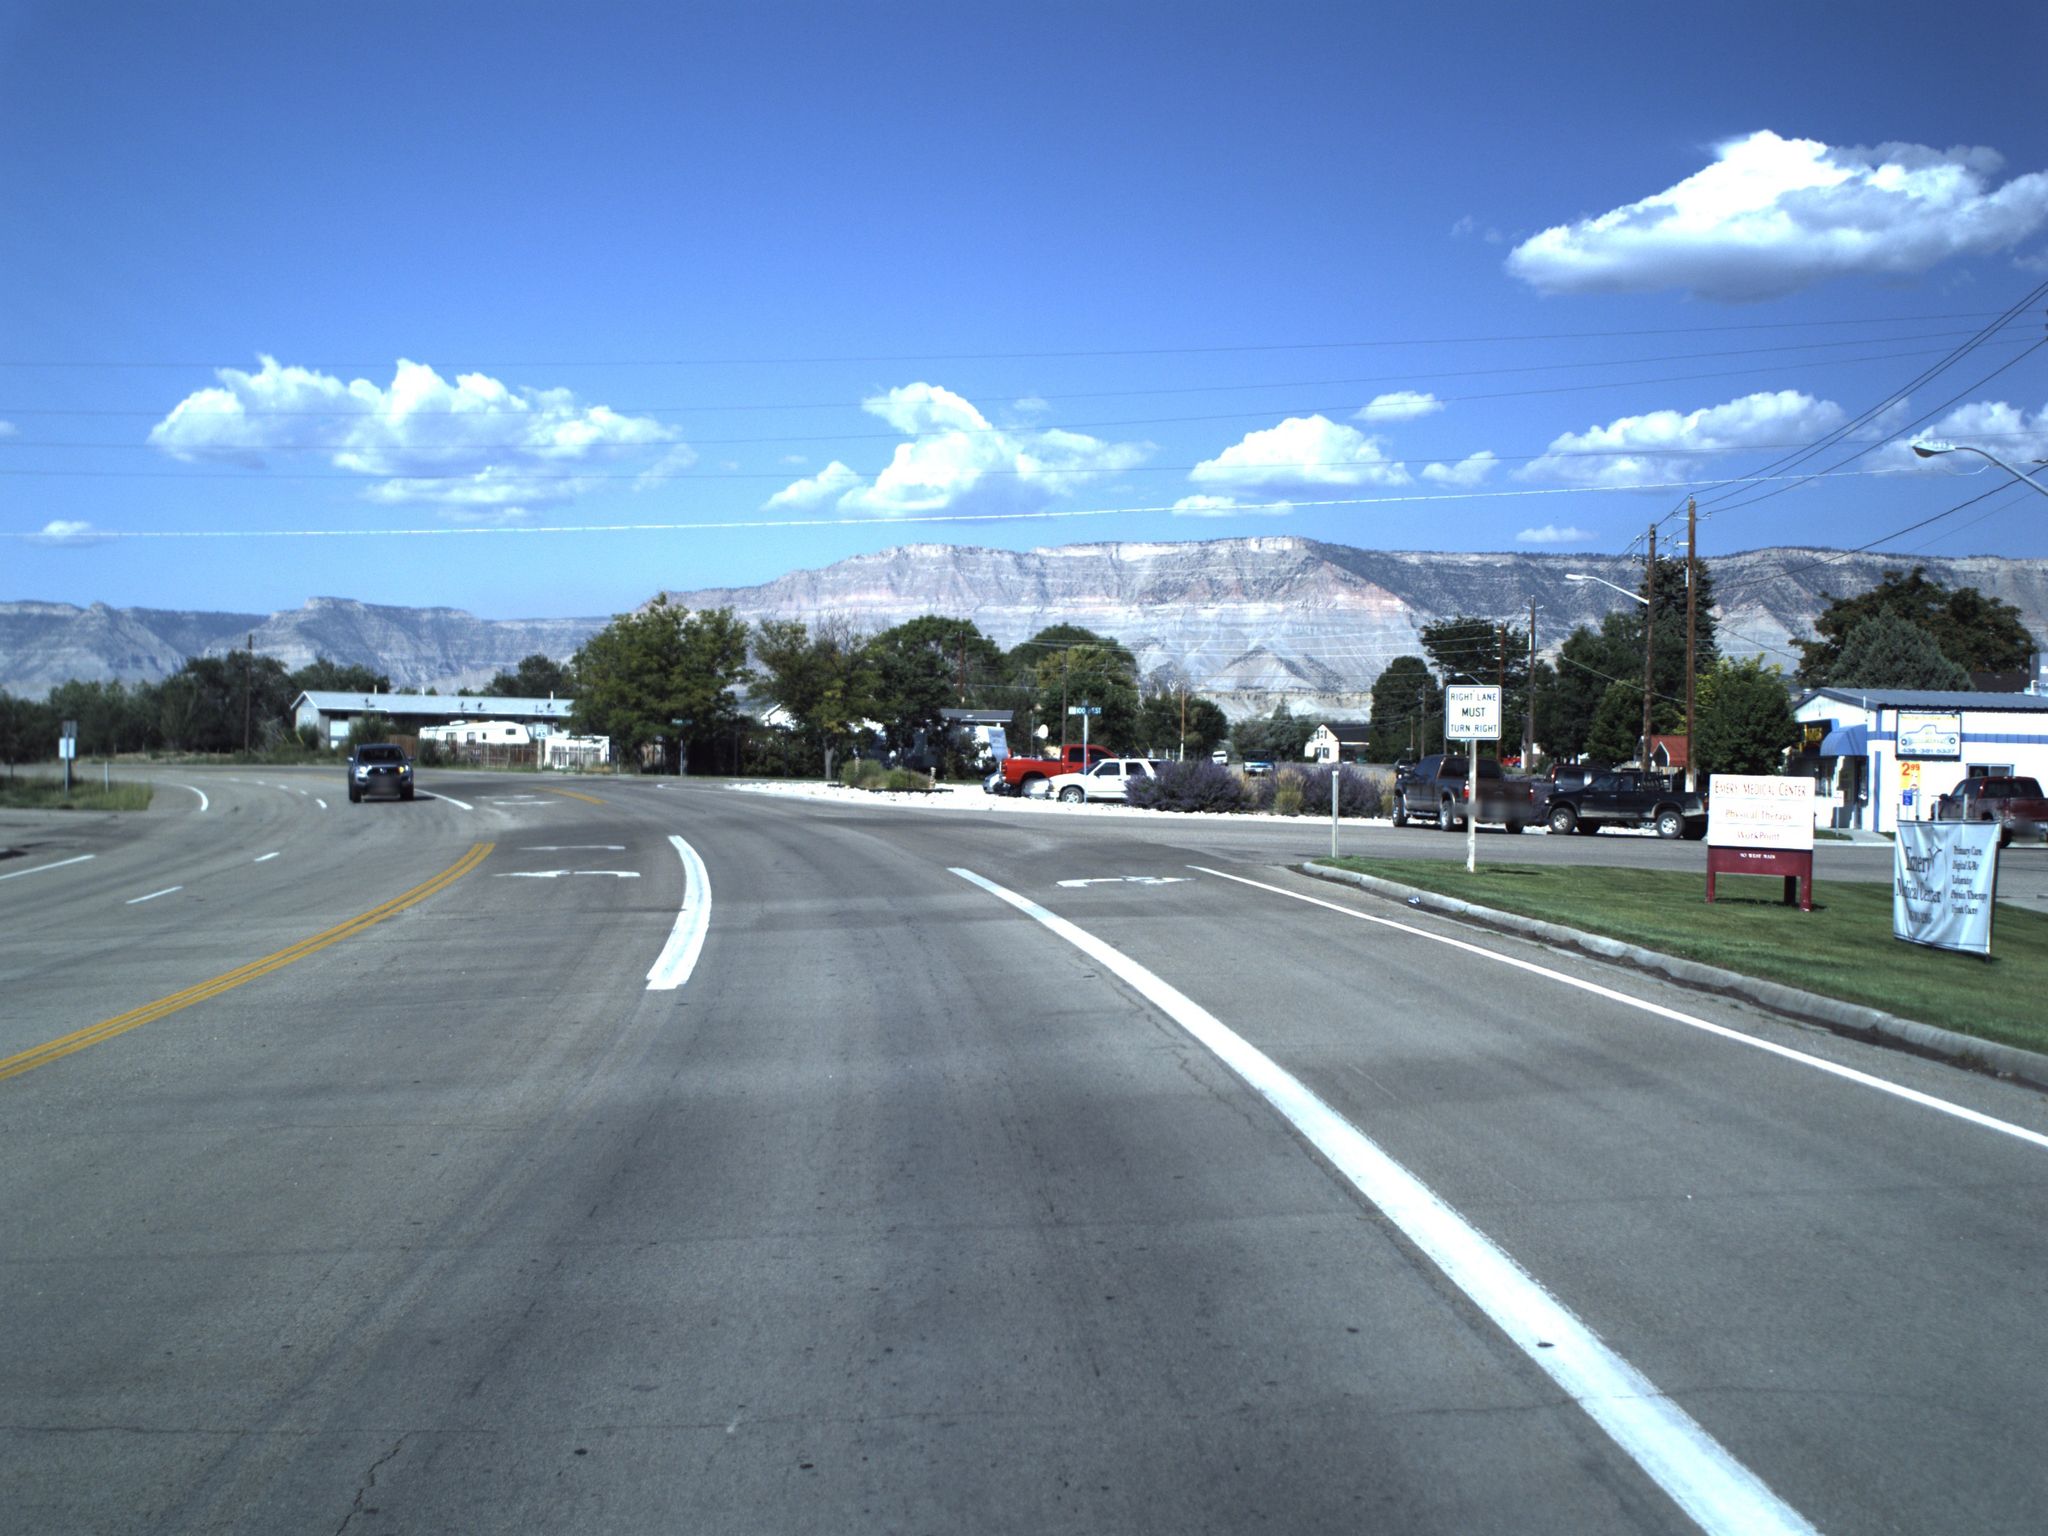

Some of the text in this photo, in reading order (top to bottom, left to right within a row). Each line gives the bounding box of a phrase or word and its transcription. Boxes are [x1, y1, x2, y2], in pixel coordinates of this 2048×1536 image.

[1451, 693, 1497, 701] RIGHT LANE
[1461, 707, 1485, 717] MUST
[1451, 724, 1497, 732] TURN RIGHT
[1715, 780, 1806, 797] EMERY MEDICAL CENTER
